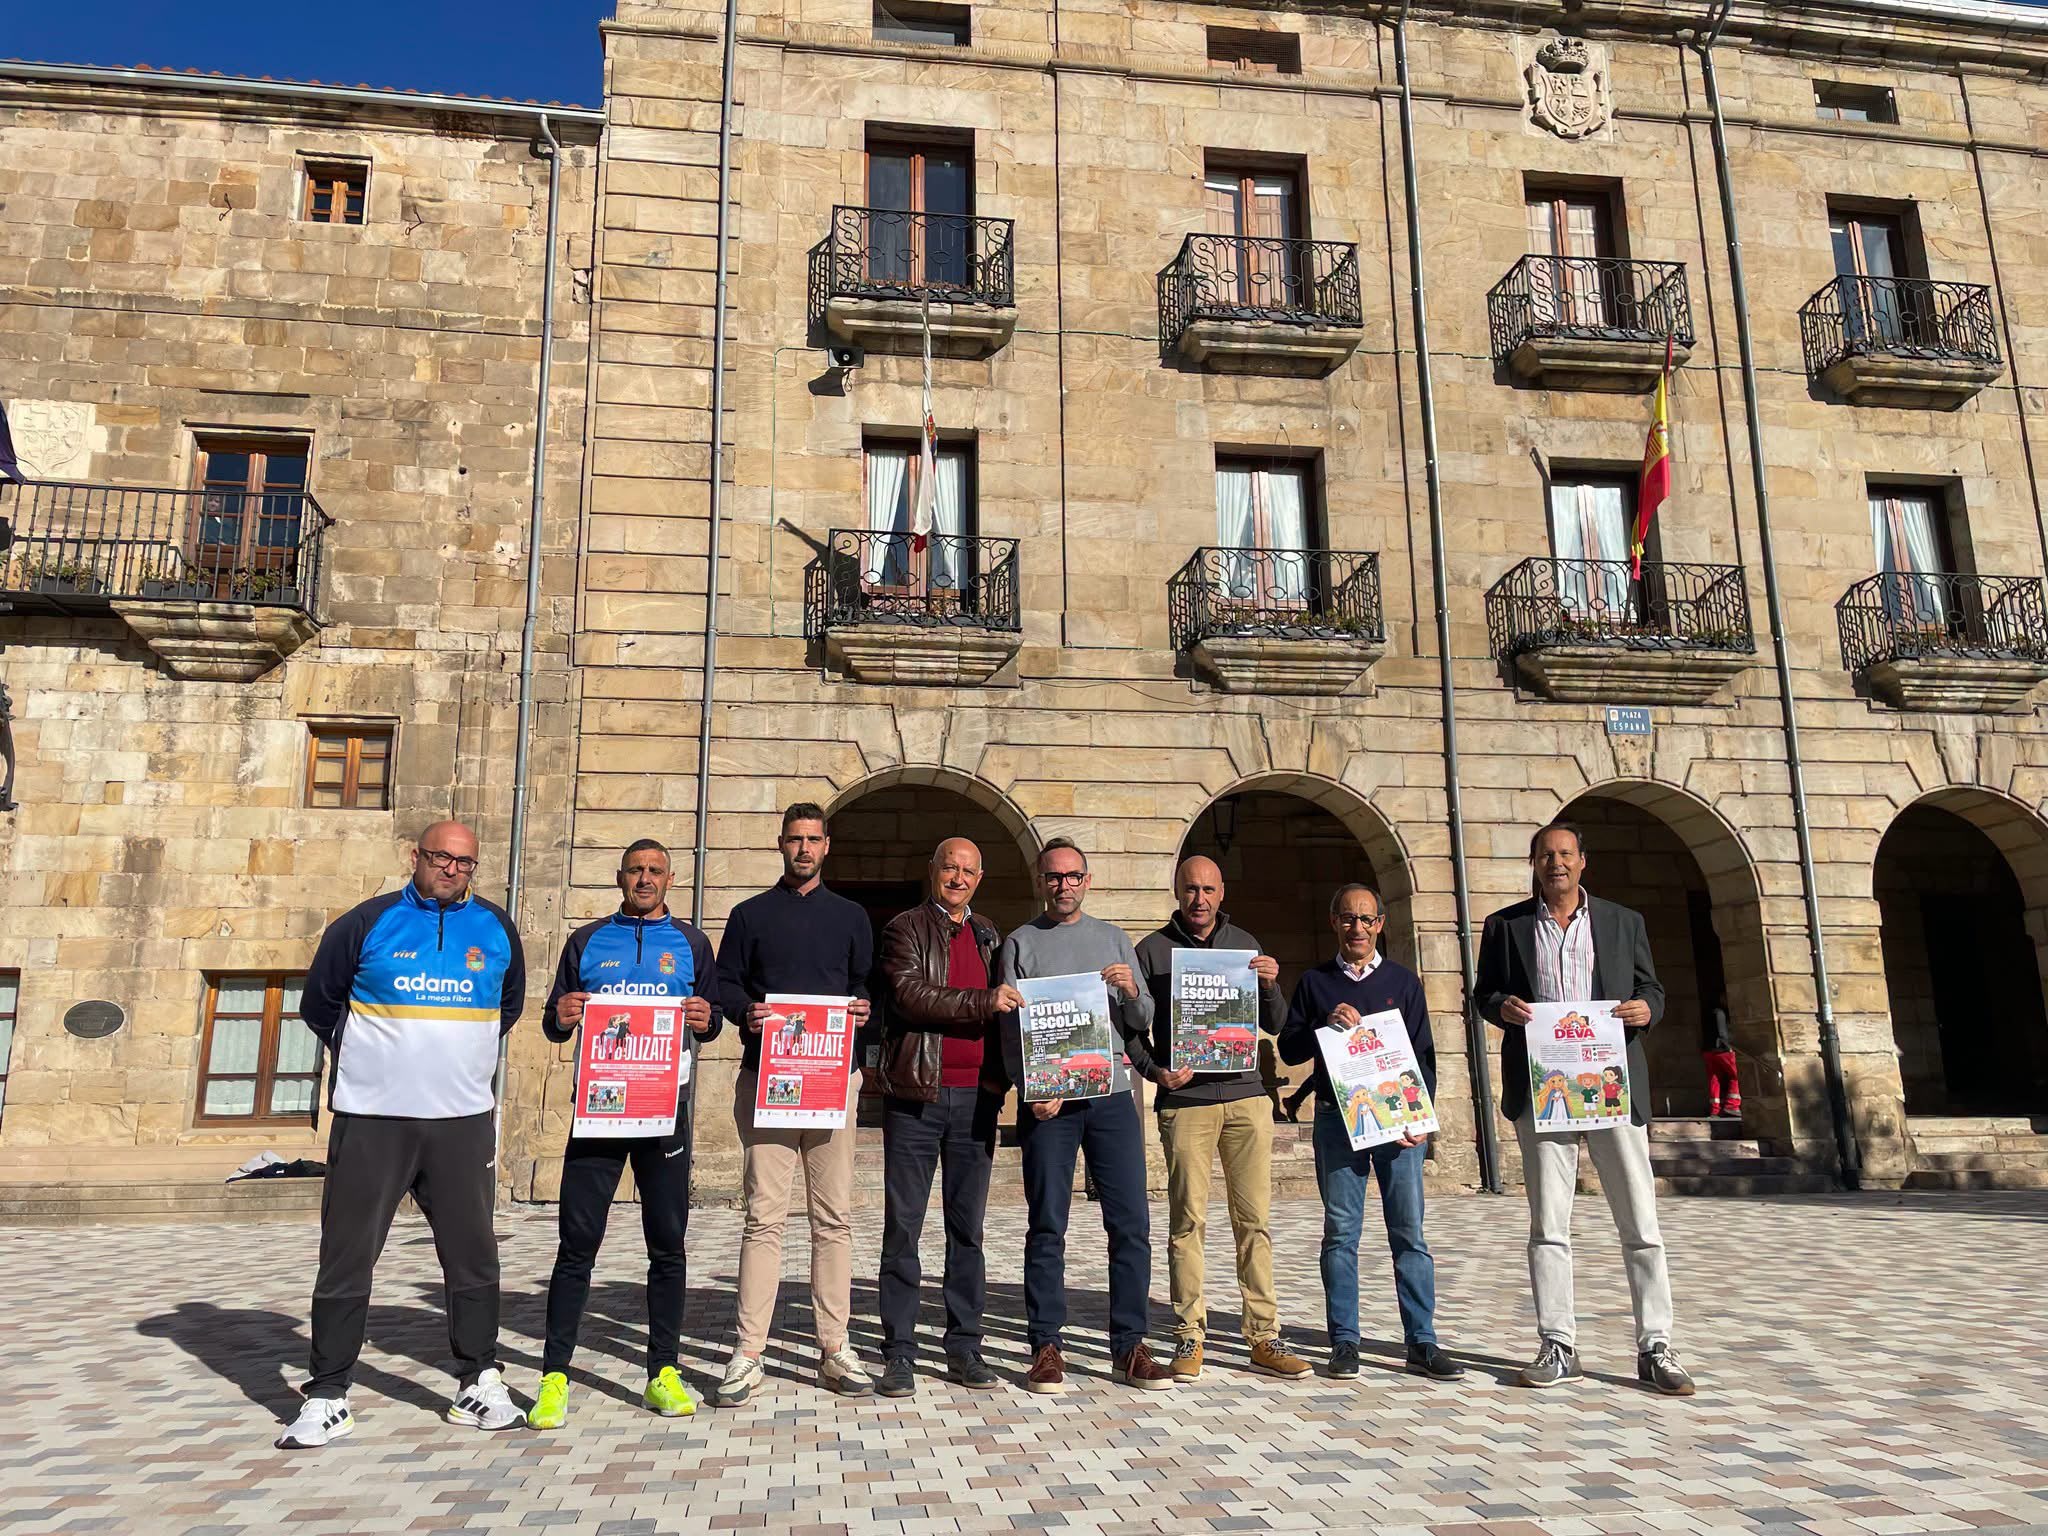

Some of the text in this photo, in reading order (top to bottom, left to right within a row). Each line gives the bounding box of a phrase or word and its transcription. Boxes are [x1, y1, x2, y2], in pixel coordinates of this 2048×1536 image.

[1621, 711, 1642, 719] PLAZA
[393, 972, 473, 993] adamo
[600, 979, 668, 995] adamo
[1181, 972, 1229, 987] FÚTBOL
[415, 993, 472, 1003] La mega fibra
[1181, 987, 1239, 1000] ESCOLAR
[1029, 999, 1079, 1017] FÚTBOL
[1030, 1012, 1091, 1031] ESCOLAR
[1554, 1028, 1596, 1039] DEVA
[1348, 1039, 1385, 1056] DEVA
